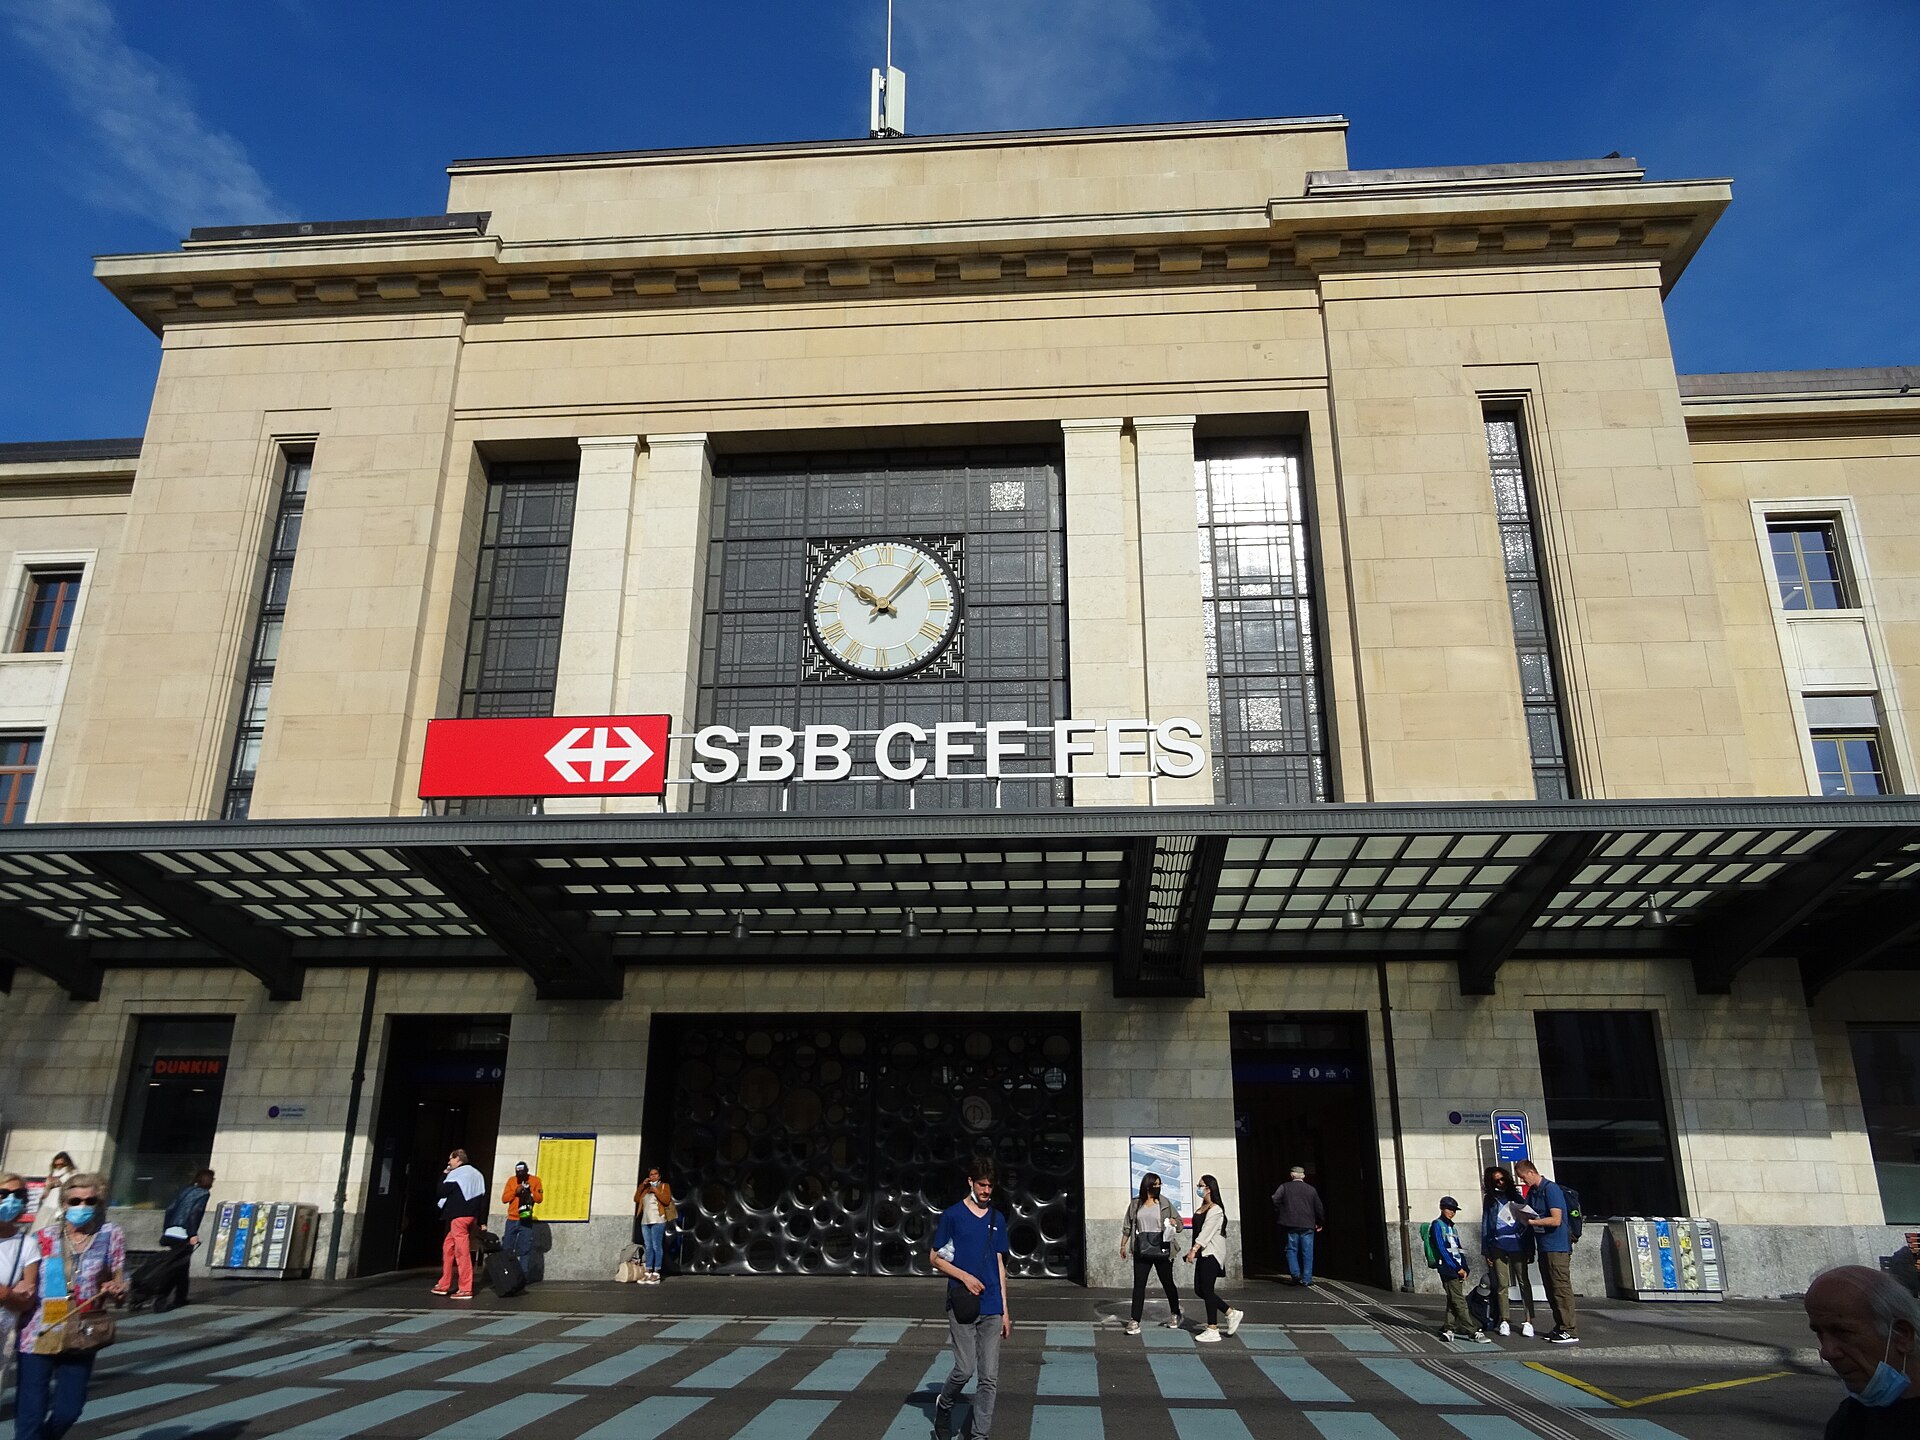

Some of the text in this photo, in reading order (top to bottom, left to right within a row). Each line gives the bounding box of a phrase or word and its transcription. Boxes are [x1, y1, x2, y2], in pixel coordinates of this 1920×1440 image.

[847, 551, 866, 573] XI
[876, 546, 894, 565] XII
[826, 575, 848, 590] X
[922, 571, 943, 588] II
[817, 600, 839, 614] IX
[928, 599, 949, 611] III
[821, 620, 847, 646] VIII
[919, 620, 944, 641] IIII
[841, 639, 863, 664] VII
[875, 646, 889, 668] VI
[904, 641, 918, 660] V
[691, 717, 1206, 783] SBB CFF FFS
[155, 1060, 221, 1073] DUNKIN
